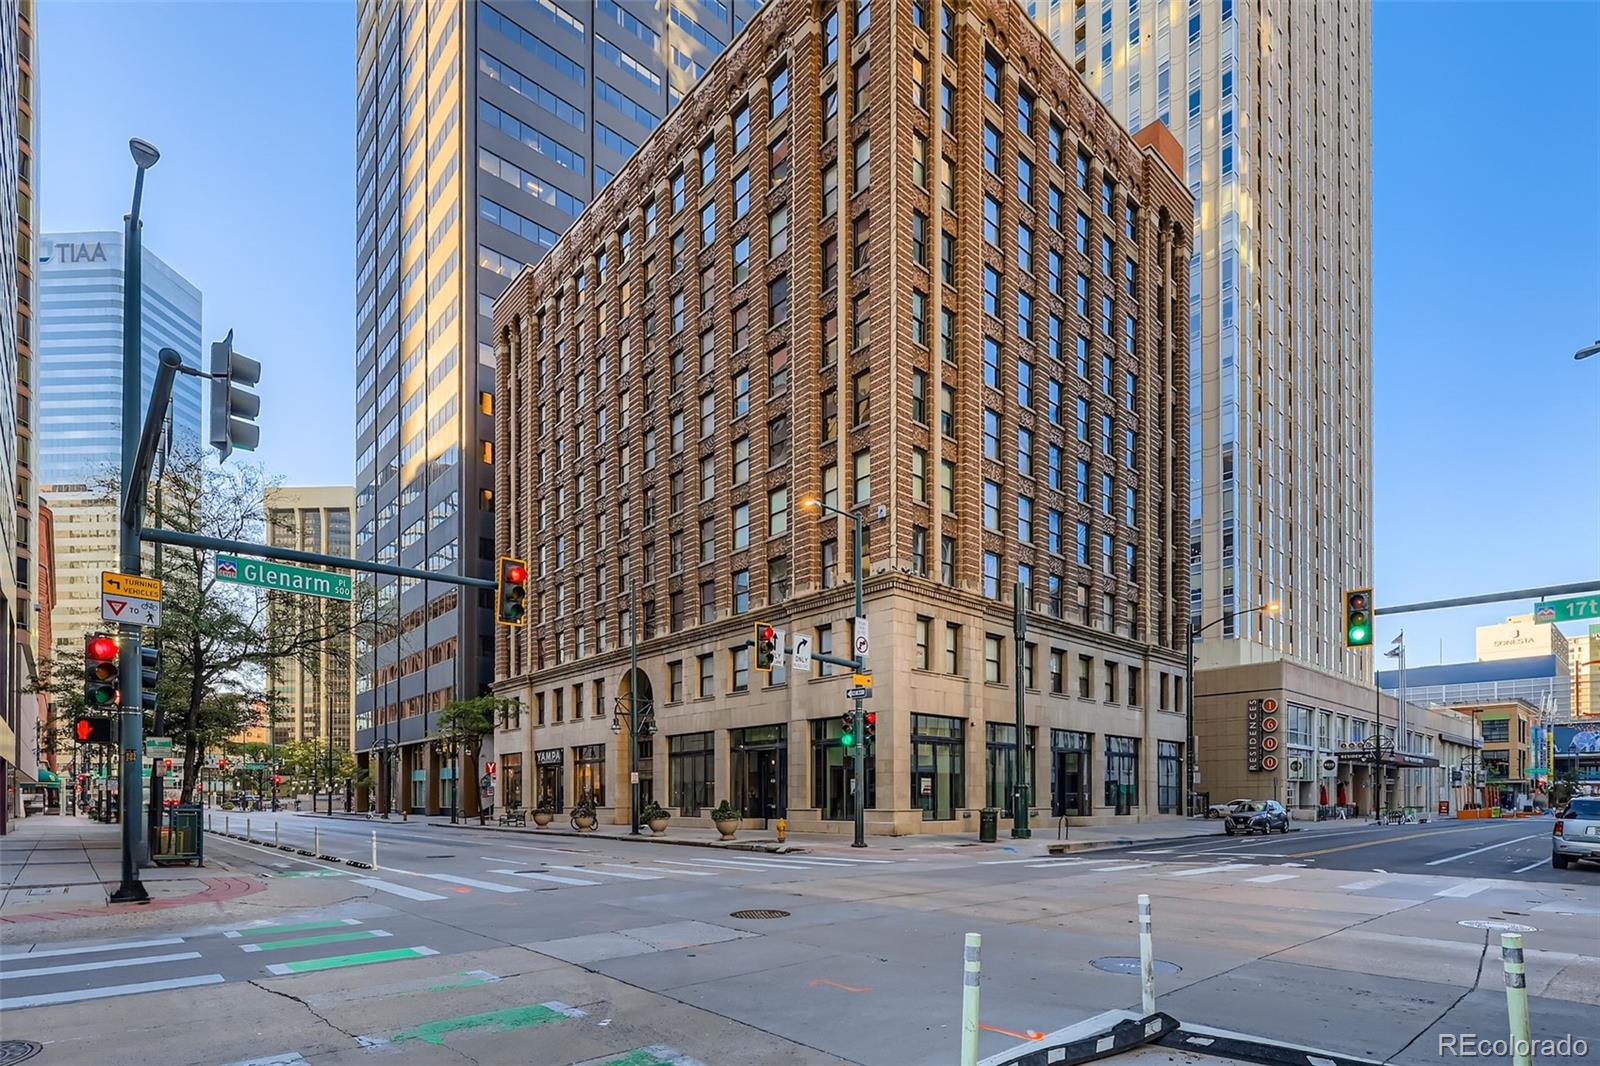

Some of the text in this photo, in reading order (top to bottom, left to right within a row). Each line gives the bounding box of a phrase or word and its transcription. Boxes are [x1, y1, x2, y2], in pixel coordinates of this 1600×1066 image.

[55, 241, 107, 263] TIAA
[125, 579, 158, 589] TURNING
[244, 564, 331, 593] Glenarm
[123, 587, 159, 598] VEHICLES
[334, 587, 350, 596] 500
[129, 607, 140, 615] TO
[1493, 637, 1535, 648] SONESTA
[795, 655, 809, 664] ONLY
[1249, 699, 1257, 771] RESIDENCES
[537, 751, 561, 763] YAMPA
